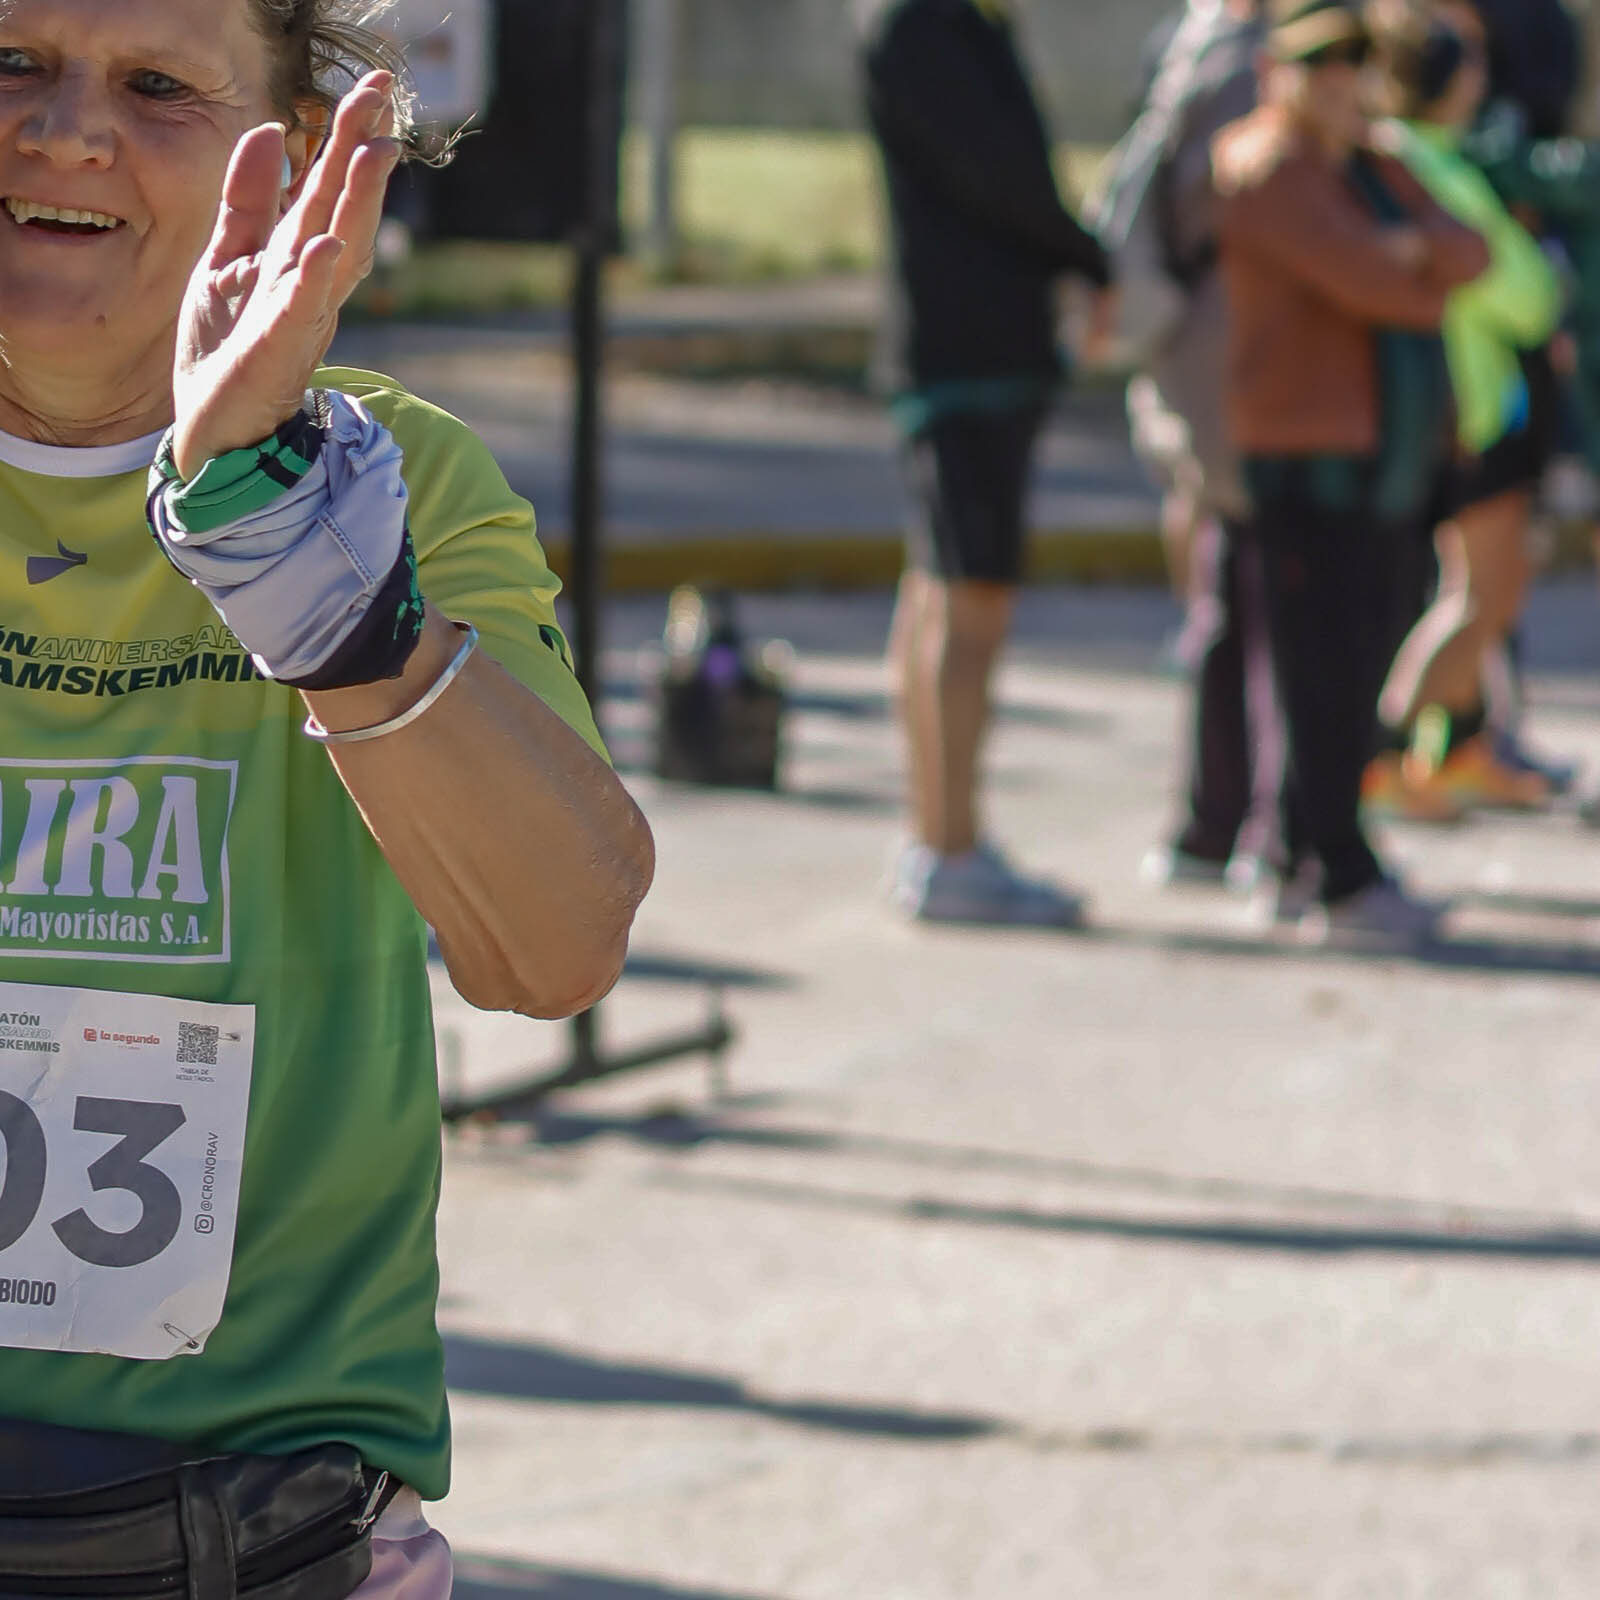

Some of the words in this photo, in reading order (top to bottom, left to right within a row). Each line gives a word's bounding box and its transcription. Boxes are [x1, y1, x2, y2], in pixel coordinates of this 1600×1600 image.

[0, 906, 150, 944] Mayoristas
[160, 913, 209, 945] S.A.
[200, 1131, 219, 1212] @CRONORAV
